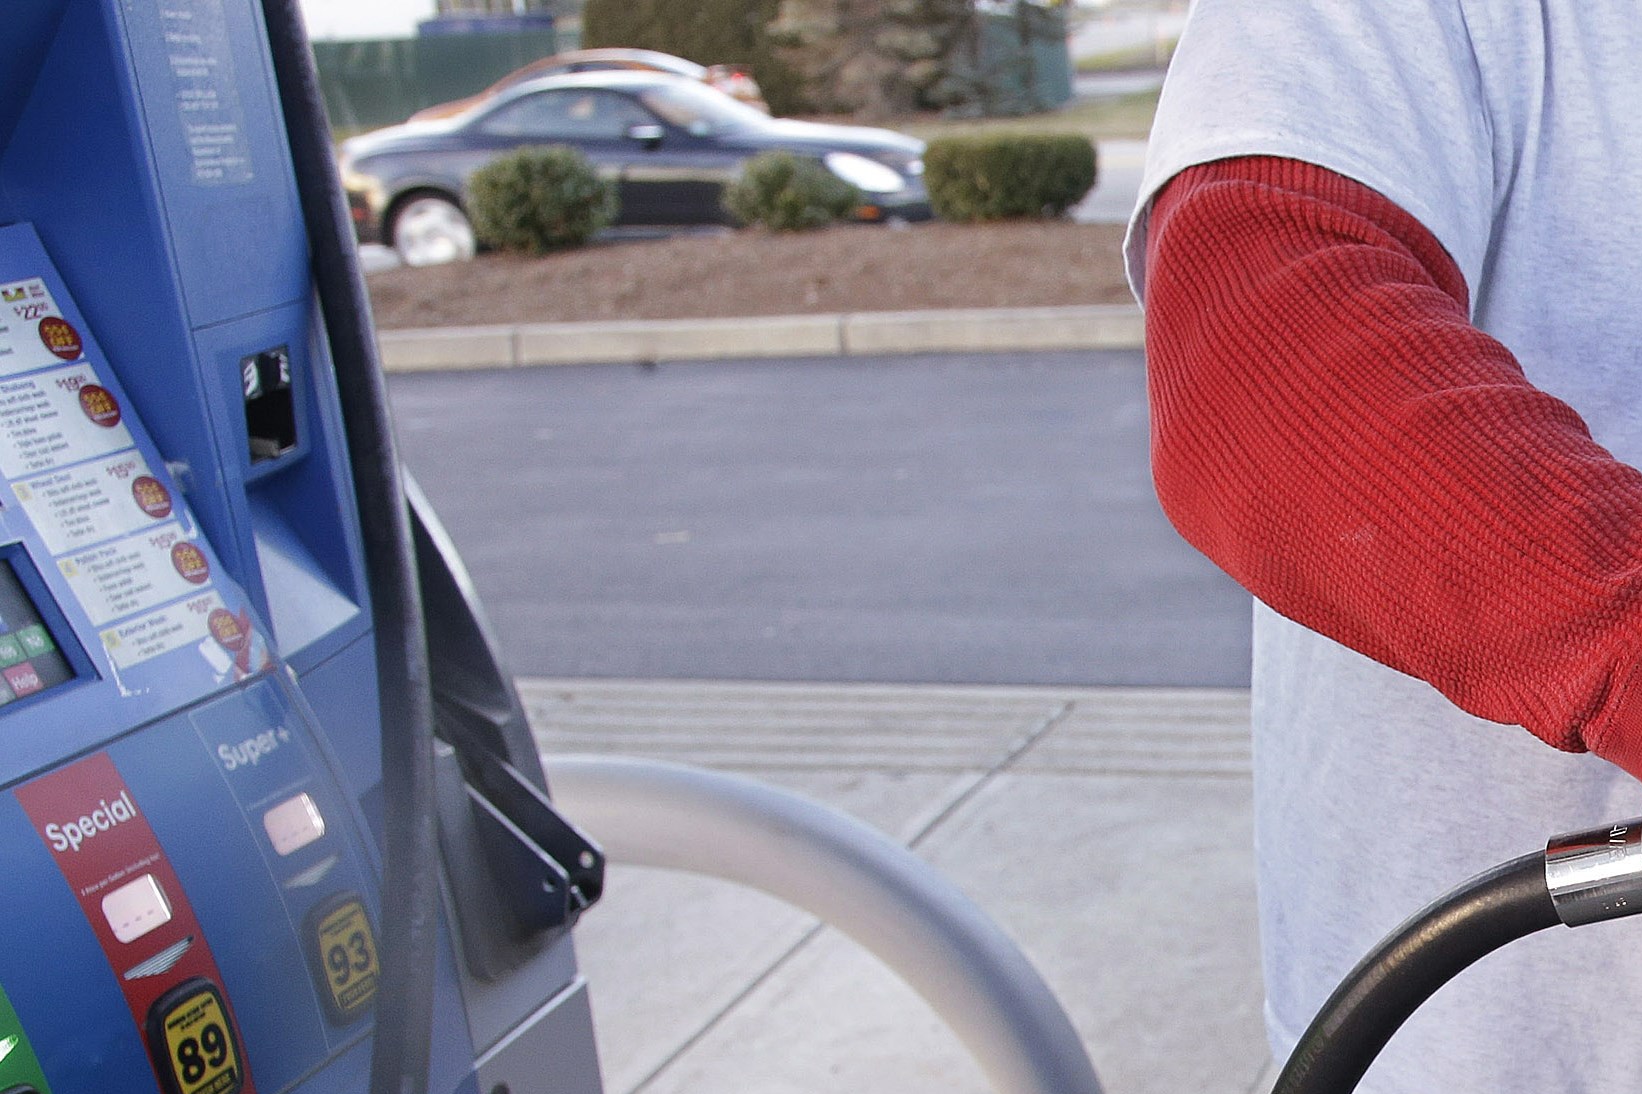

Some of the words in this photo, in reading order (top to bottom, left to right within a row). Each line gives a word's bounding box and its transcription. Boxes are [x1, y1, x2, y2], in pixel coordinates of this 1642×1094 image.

[45, 789, 137, 852] Special
[327, 928, 370, 986] 93
[177, 1023, 228, 1085] 89
